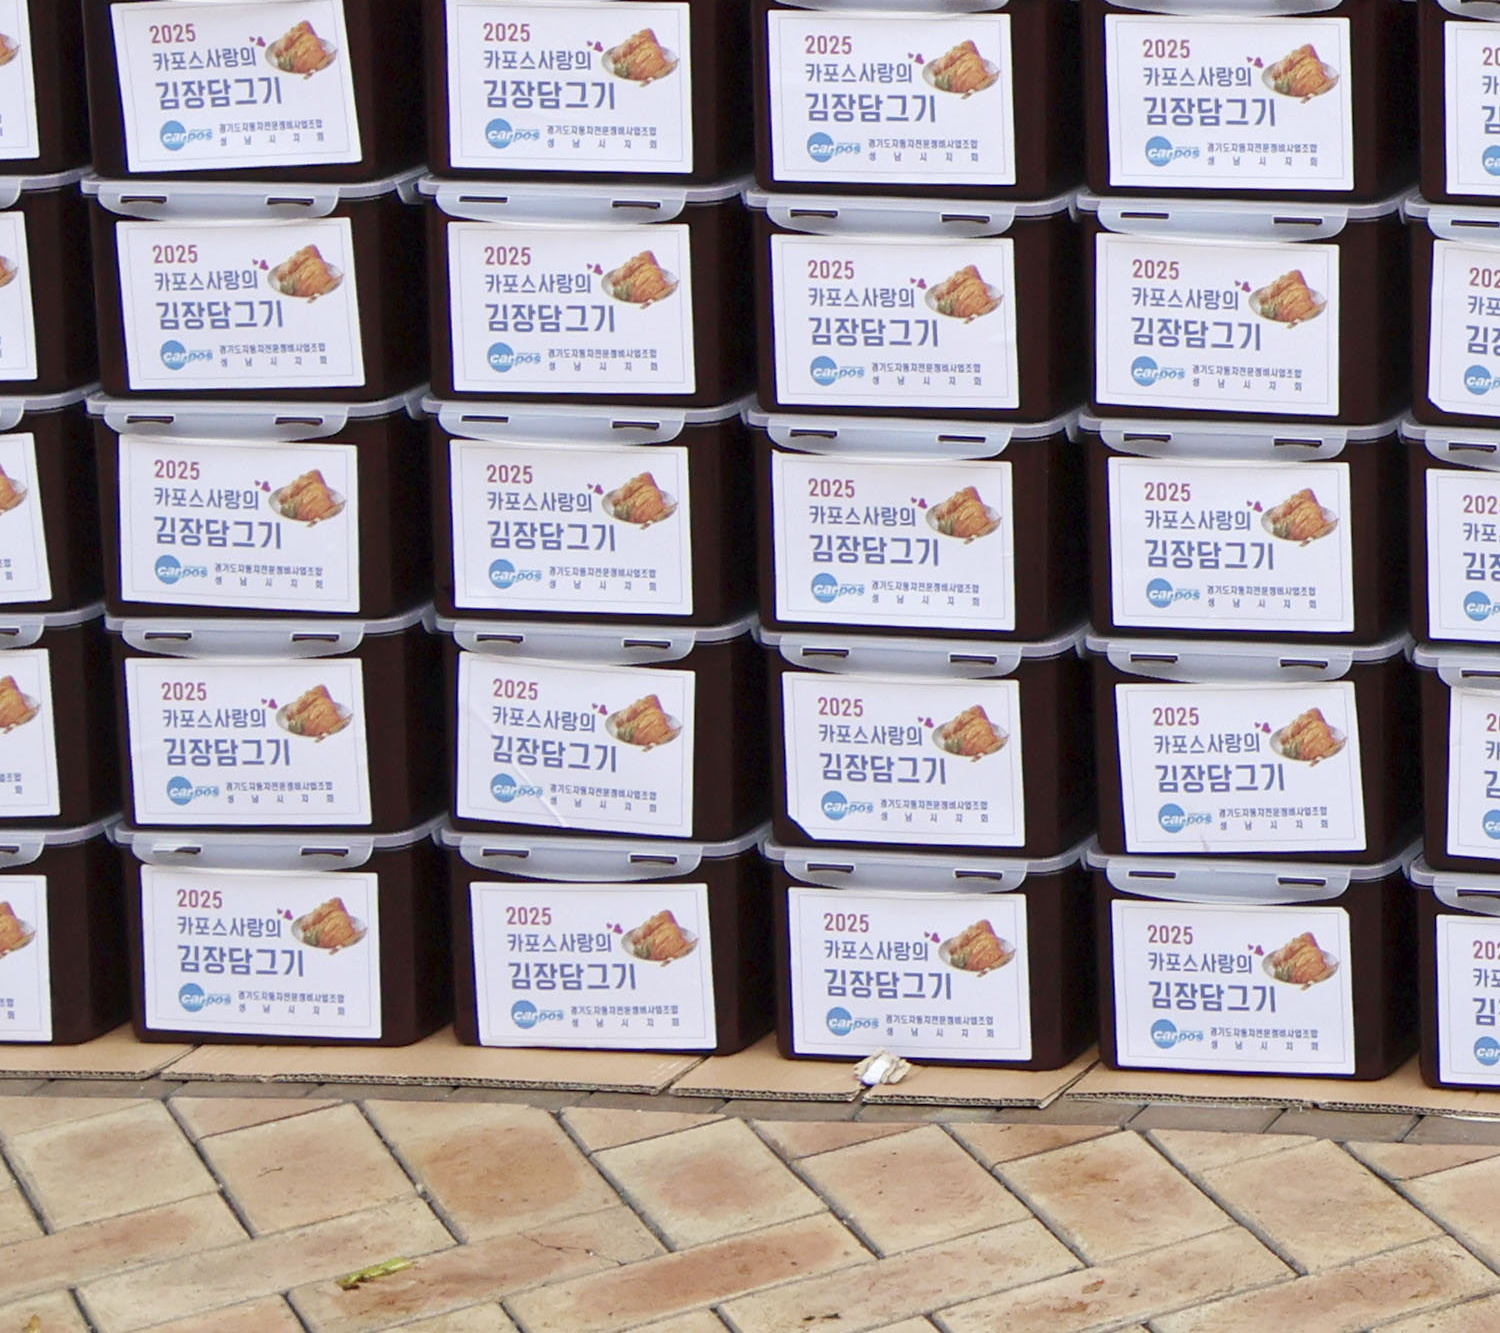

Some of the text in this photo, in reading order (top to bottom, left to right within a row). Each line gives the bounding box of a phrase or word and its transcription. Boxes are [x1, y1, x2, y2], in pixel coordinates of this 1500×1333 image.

[148, 22, 197, 44] 2025
[152, 46, 258, 72] 카포스사랑의
[1141, 39, 1191, 59] 2025
[1142, 66, 1253, 88] 카포스사랑의
[155, 75, 283, 111] 김장담그기
[1143, 96, 1276, 127] 김장담그기
[483, 246, 531, 266] 2025
[484, 273, 592, 294] 카포스사랑의
[485, 303, 616, 333] 김장담그기
[807, 477, 856, 498] 2025
[808, 504, 917, 528] 카포스사랑의
[809, 534, 940, 567] 김장담그기
[159, 682, 207, 701] 2025
[161, 709, 267, 729] 카포스사랑의
[163, 738, 291, 766] 김장담그기
[822, 913, 870, 933] 2025
[823, 939, 930, 962] 카포스사랑의
[824, 968, 952, 1000] 김장담그기
